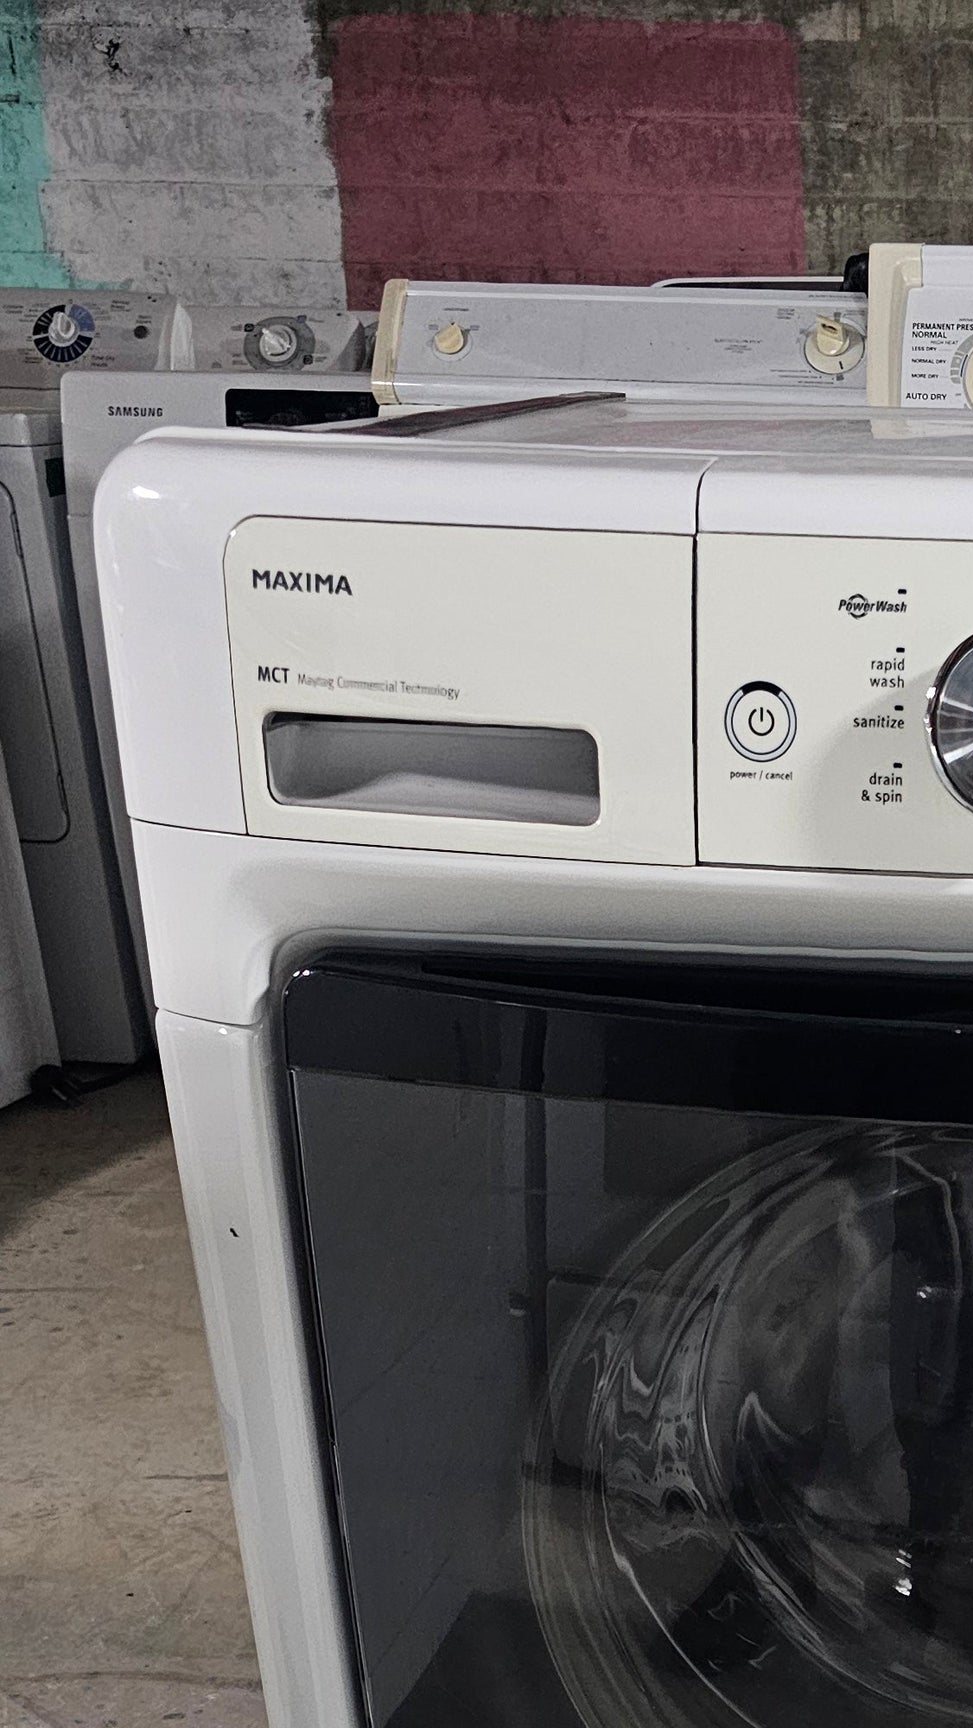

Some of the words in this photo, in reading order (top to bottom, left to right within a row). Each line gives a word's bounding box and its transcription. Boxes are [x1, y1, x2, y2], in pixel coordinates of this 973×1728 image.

[912, 322, 955, 330] PERMANENT
[912, 331, 948, 339] NORMAL
[905, 392, 929, 400] AUTO
[930, 393, 947, 401] DRY
[108, 406, 163, 417] SAMSUNG
[252, 569, 353, 596] MAXIMA
[838, 598, 907, 613] PowerWash
[871, 657, 905, 674] rapid
[257, 665, 290, 684] MCT
[869, 674, 905, 689] wash
[853, 715, 905, 729] sanitize
[730, 770, 757, 780] power
[765, 771, 793, 781] cancel
[869, 772, 903, 787] drain
[861, 789, 871, 802] &
[875, 789, 903, 805] spin
